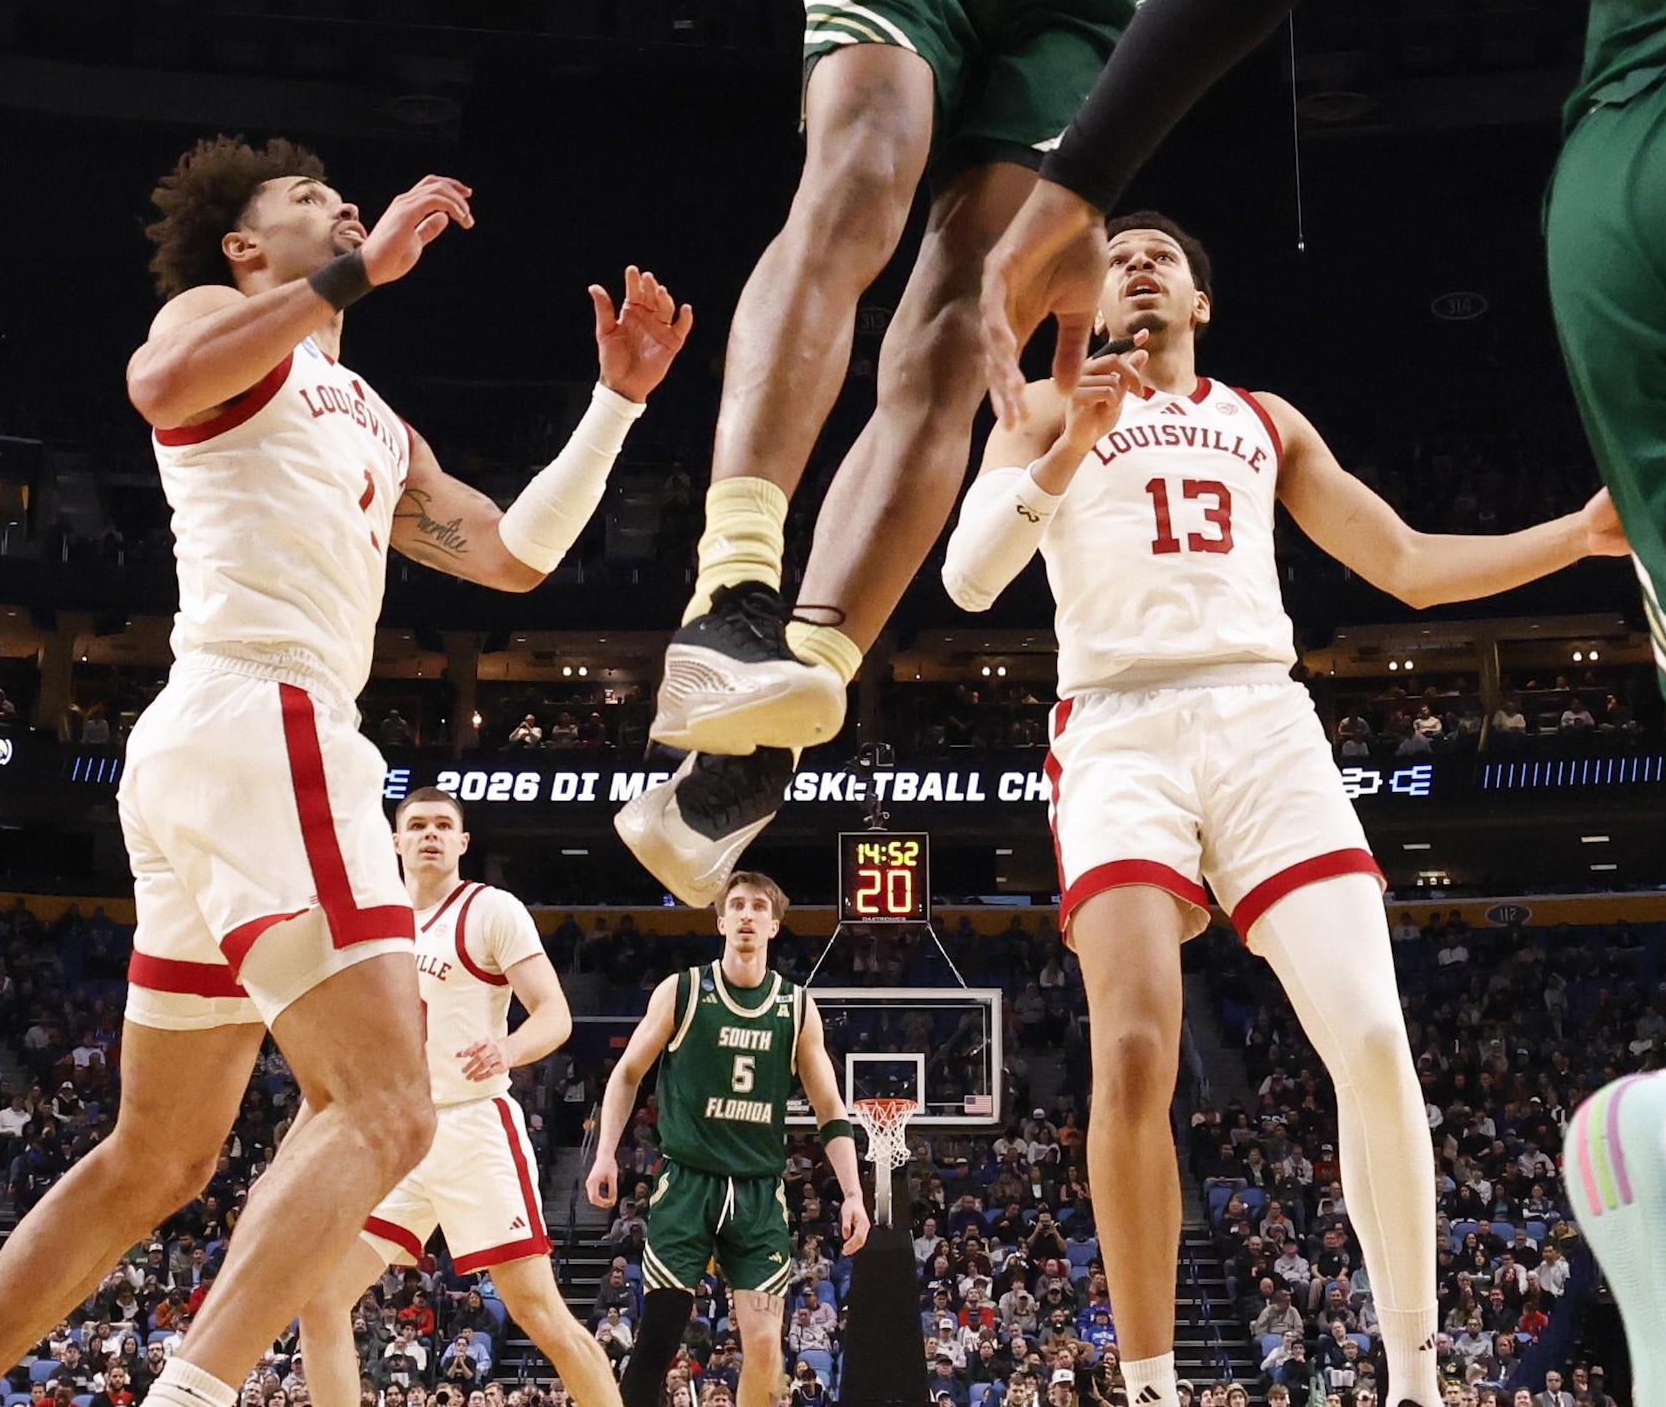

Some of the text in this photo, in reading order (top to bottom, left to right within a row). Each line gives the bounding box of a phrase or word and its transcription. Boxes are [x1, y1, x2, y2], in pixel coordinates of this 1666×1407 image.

[1091, 425, 1267, 474] LOUISVILLE
[1145, 478, 1235, 555] 13
[436, 771, 542, 802] 2026
[550, 772, 598, 802] DI
[858, 841, 919, 867] 14:52
[856, 869, 912, 914] 20
[718, 1026, 773, 1051] SOUTH
[731, 1054, 756, 1093] 5
[705, 1097, 773, 1125] FLORIDA
